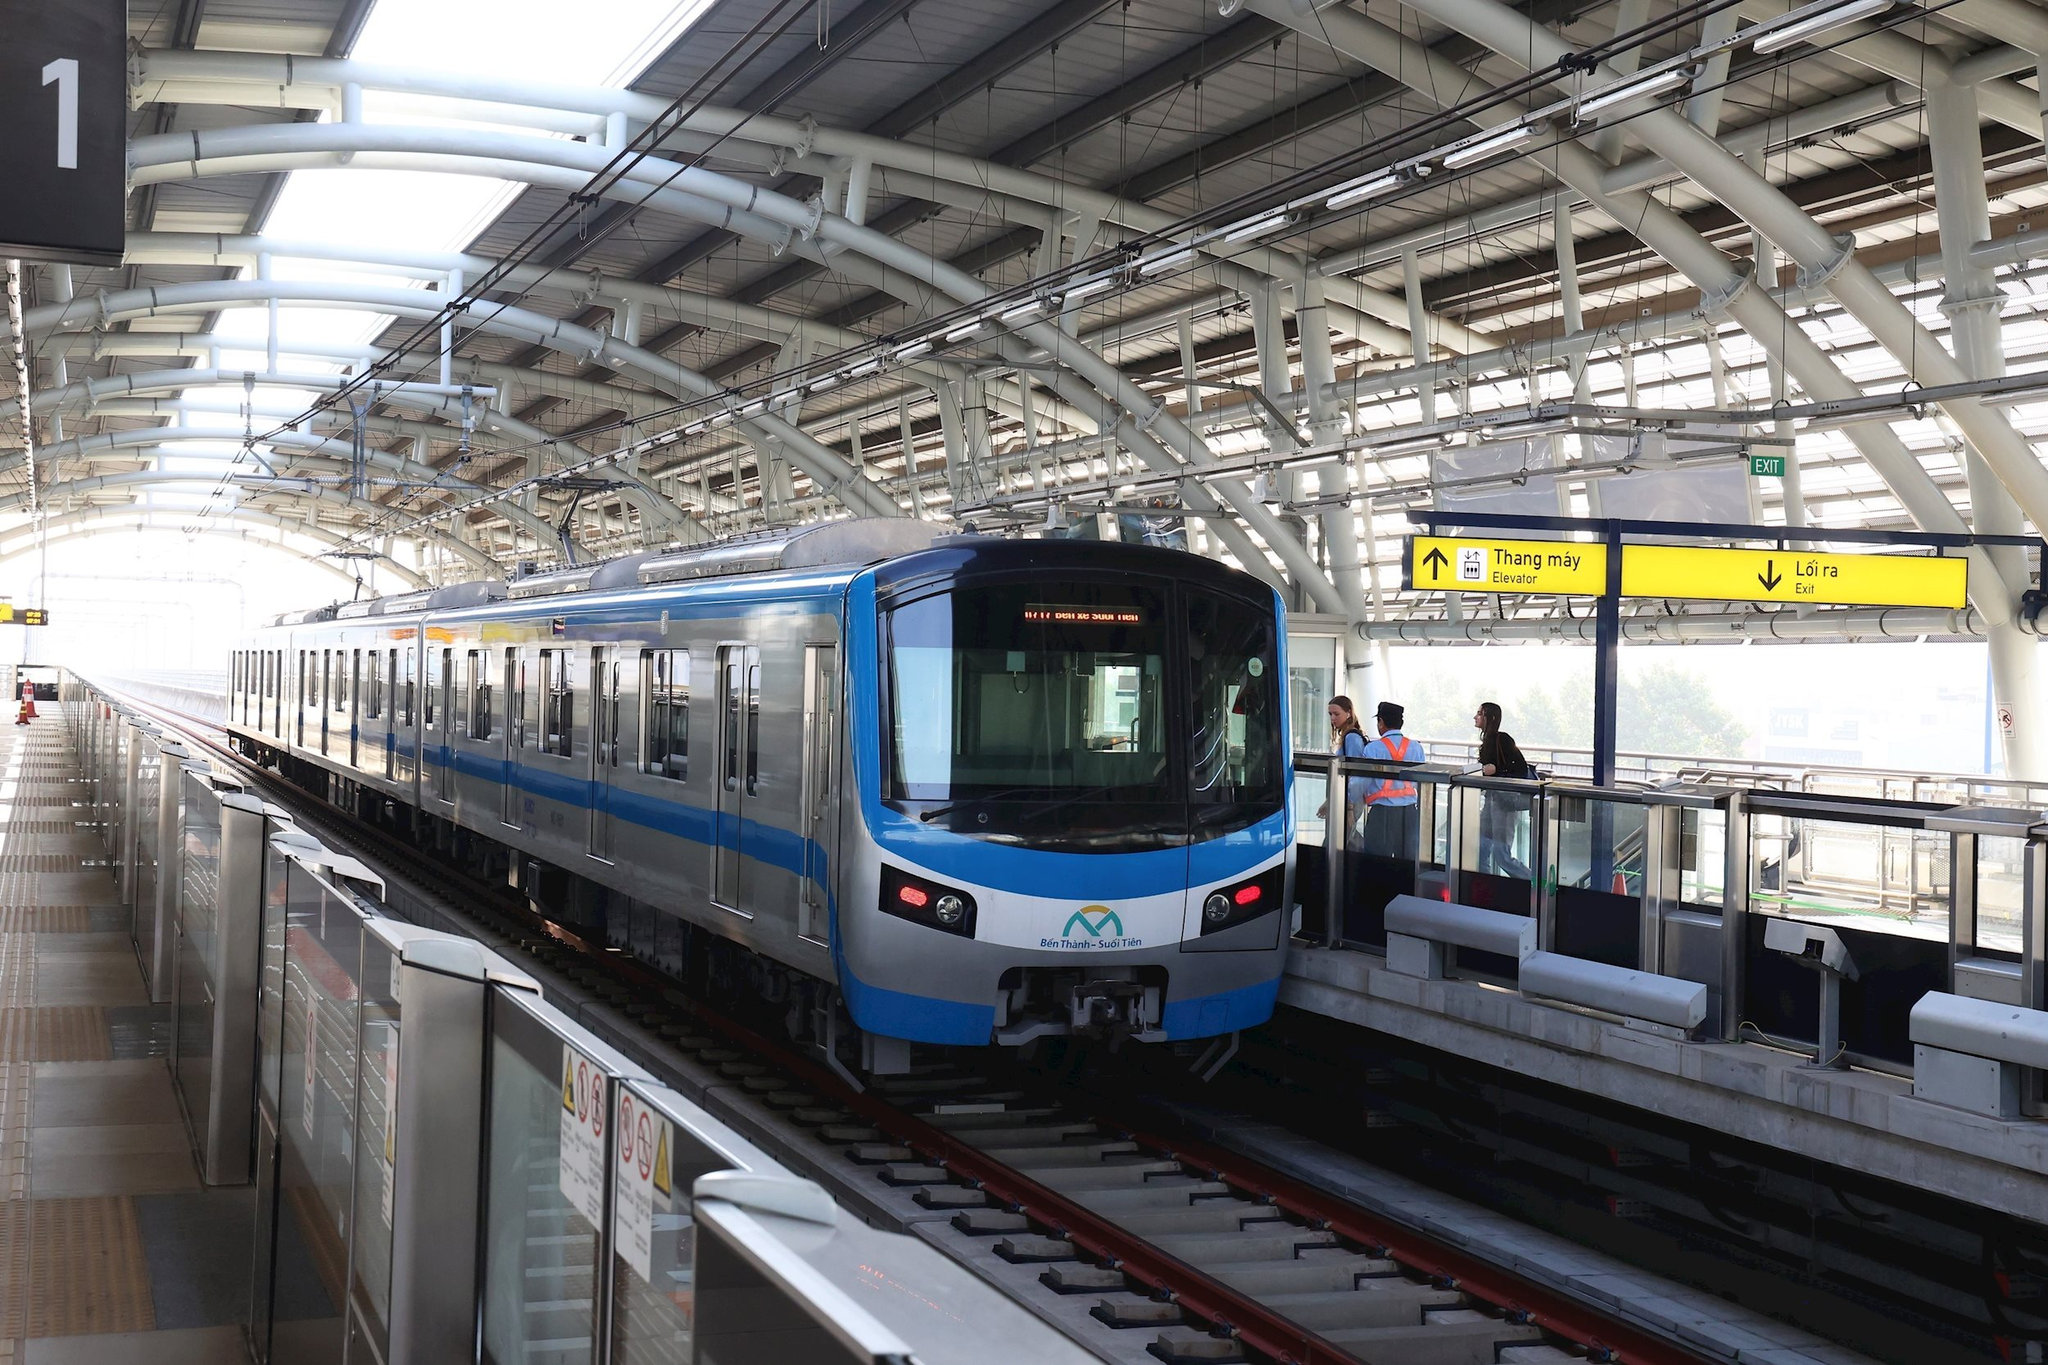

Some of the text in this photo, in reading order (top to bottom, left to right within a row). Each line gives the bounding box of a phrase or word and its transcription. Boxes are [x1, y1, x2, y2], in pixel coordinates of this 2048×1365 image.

[42, 57, 79, 169] 1
[1755, 458, 1779, 474] EXIT
[1494, 548, 1581, 571] Thang máy
[1796, 559, 1838, 577] Lối ra
[1492, 571, 1537, 584] Elevator
[1795, 582, 1815, 594] Exit
[1040, 938, 1059, 948] Bến
[1060, 939, 1090, 948] Thành
[1098, 937, 1120, 948] Suối
[1122, 937, 1142, 947] Tiên
